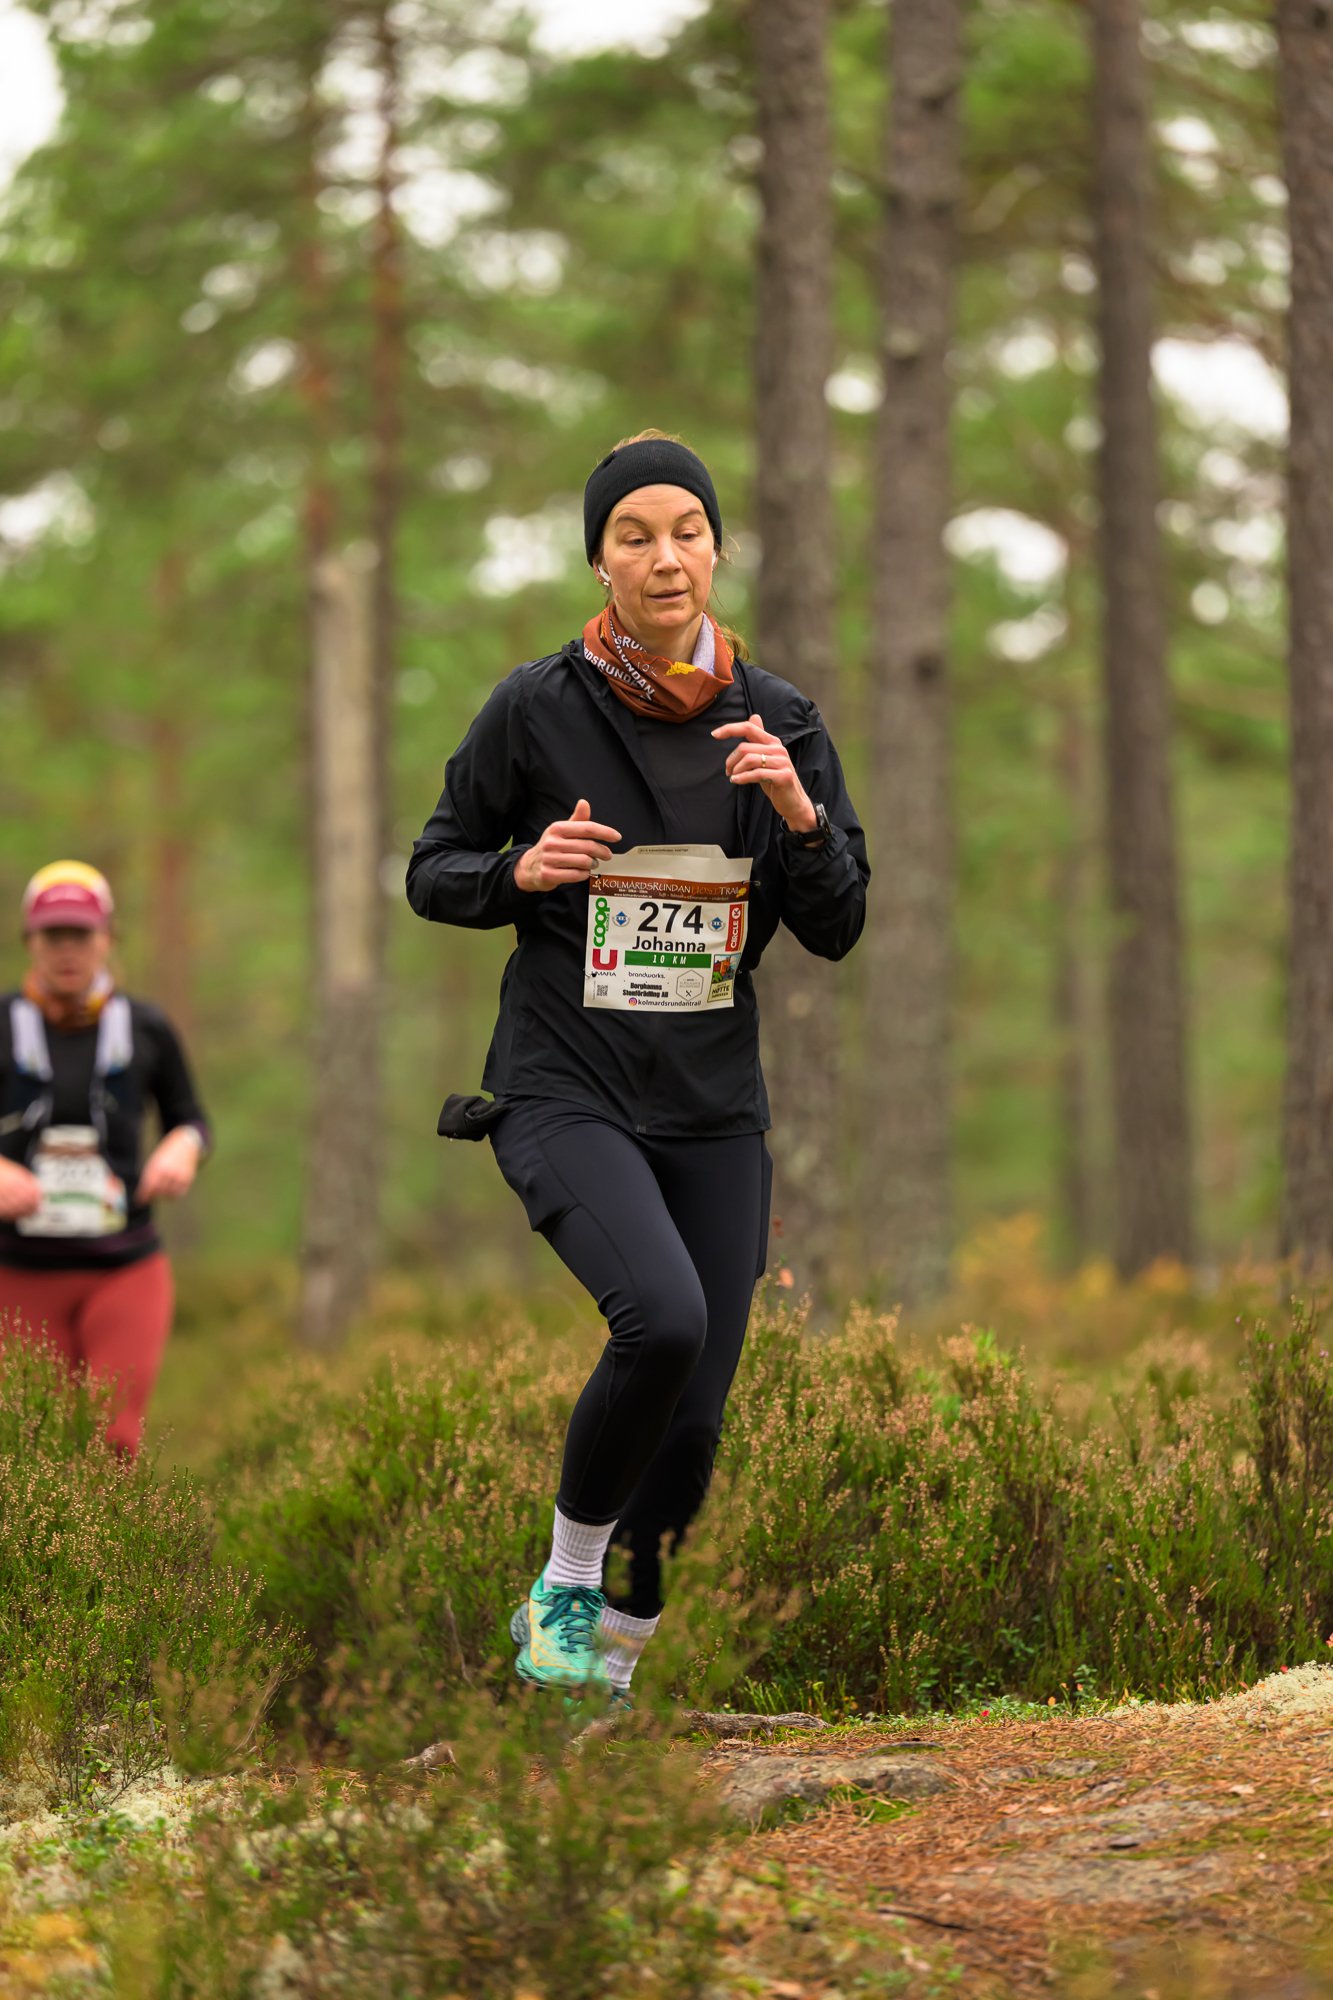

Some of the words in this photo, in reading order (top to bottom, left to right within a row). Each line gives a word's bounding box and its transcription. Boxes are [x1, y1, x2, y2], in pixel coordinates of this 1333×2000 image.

[593, 897, 610, 947] coop
[637, 901, 704, 935] 274
[632, 935, 706, 953] Johanna
[730, 920, 739, 949] CIRCLE
[652, 954, 665, 964] 10
[672, 955, 687, 965] KM
